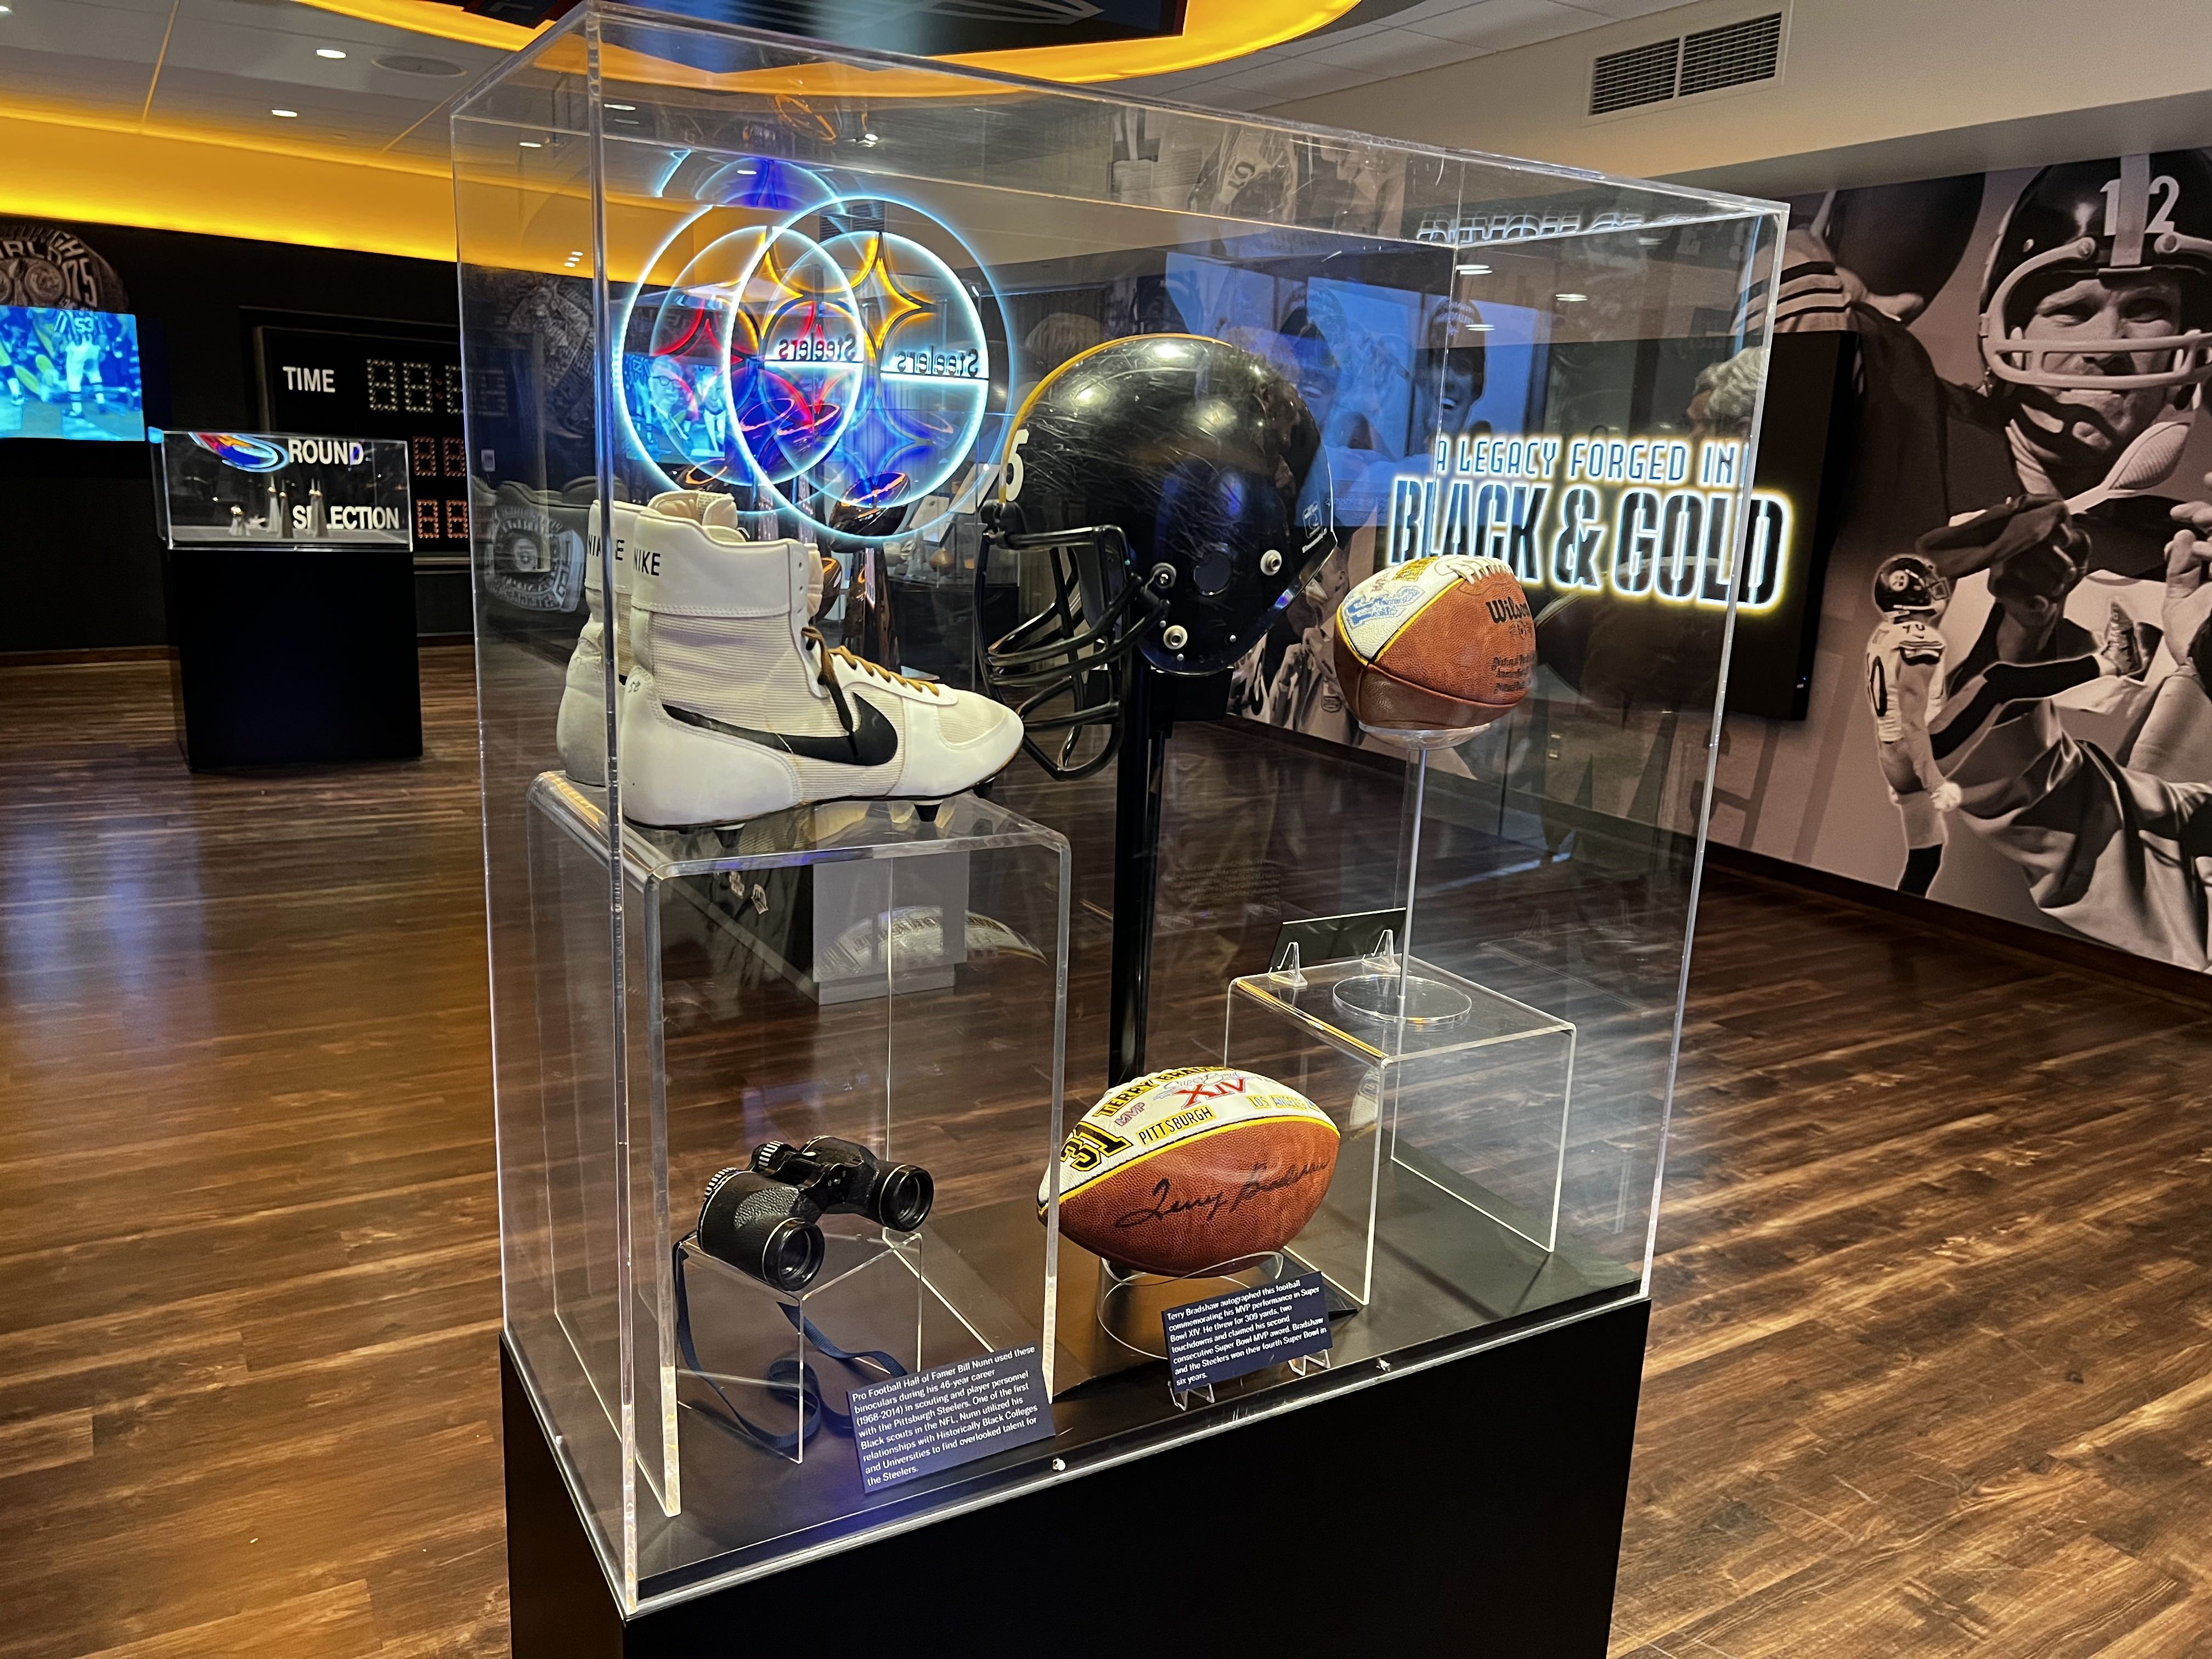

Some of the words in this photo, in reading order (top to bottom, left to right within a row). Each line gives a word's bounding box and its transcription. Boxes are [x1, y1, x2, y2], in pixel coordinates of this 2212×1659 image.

[2100, 176, 2180, 236] 12
[283, 365, 336, 393] TIME
[288, 439, 364, 465] ROUND
[1436, 439, 1448, 474] A
[1458, 439, 1560, 477] LEGACY
[1570, 440, 1688, 483] FORGED
[1701, 444, 1738, 487] IN
[292, 505, 400, 531] SECTION
[633, 547, 661, 577] NIKE
[1390, 476, 1549, 584] BLACK
[1553, 486, 1605, 590] &
[1612, 487, 1791, 607] GOLD
[1486, 596, 1532, 624] Wilson
[1114, 1102, 1147, 1127] MVP
[1173, 1077, 1246, 1110] XIV
[1249, 1096, 1269, 1107] LOS
[1060, 1121, 1134, 1172] 31
[1138, 1107, 1214, 1145] PITTSBURGH
[1167, 1312, 1184, 1321] Terry
[1186, 1302, 1219, 1316] Bradshaw
[1220, 1290, 1262, 1306] autographed
[1262, 1288, 1276, 1296] this
[1276, 1279, 1301, 1292] football
[1169, 1312, 1223, 1331] commemorating
[1223, 1308, 1234, 1317] his
[1235, 1303, 1251, 1314] MVP
[1251, 1294, 1293, 1311] performance
[1301, 1286, 1319, 1296] Super
[1170, 1333, 1188, 1342] Bowl
[1203, 1324, 1213, 1334] He
[1214, 1321, 1233, 1331] threw
[1234, 1317, 1243, 1325] for
[1244, 1312, 1259, 1323] 309
[1280, 1305, 1293, 1313] two
[1171, 1336, 1214, 1353] touchdowns
[1214, 1332, 1227, 1342] and
[1228, 1324, 1254, 1337] claimed
[1255, 1322, 1266, 1330] his
[1266, 1315, 1290, 1328] second
[1173, 1348, 1214, 1365] consecutive
[1214, 1342, 1234, 1353] Super
[1235, 1336, 1252, 1347] Bowl
[1253, 1330, 1269, 1342] MVP
[1269, 1326, 1291, 1337] award.
[1292, 1317, 1324, 1331] Bradshaw
[1175, 1365, 1188, 1375] and
[1189, 1363, 1201, 1372] the
[1201, 1355, 1230, 1368] Steelers
[1230, 1351, 1245, 1359] won
[1245, 1345, 1261, 1356] their
[1262, 1339, 1283, 1350] fourth
[1283, 1334, 1302, 1344] Super
[1303, 1328, 1319, 1339] Bowl
[852, 1393, 867, 1402] Pro
[868, 1381, 902, 1398] Football
[903, 1375, 920, 1388] Hall
[921, 1373, 929, 1383] of
[931, 1368, 956, 1380] Famer
[957, 1363, 970, 1374] Bill
[971, 1358, 994, 1370] Nunn
[994, 1351, 1013, 1363] used
[1014, 1346, 1035, 1358] these
[854, 1396, 898, 1415] binoculars
[899, 1387, 926, 1402] during
[926, 1383, 939, 1394] his
[939, 1376, 969, 1390] 46-year
[971, 1368, 995, 1382] career
[1176, 1378, 1187, 1386] six
[1187, 1372, 1208, 1385] years.
[856, 1405, 904, 1427] (1968-2014)
[905, 1402, 914, 1412] in
[915, 1392, 950, 1410] scouting
[950, 1388, 966, 1400] and
[966, 1382, 991, 1397] player
[991, 1370, 1029, 1389] personnel
[858, 1426, 877, 1438] with
[878, 1423, 892, 1433] the
[893, 1409, 936, 1428] Pittsburgh
[936, 1400, 972, 1416] Steelers.
[972, 1393, 989, 1406] One
[990, 1390, 998, 1401] of
[999, 1387, 1012, 1398] the
[1013, 1382, 1030, 1393] first
[860, 1436, 884, 1451] Black
[886, 1429, 913, 1443] scouts
[915, 1425, 923, 1434] in
[924, 1420, 938, 1431] the
[959, 1409, 981, 1422] Nunn
[982, 1401, 1011, 1415] utilized
[1011, 1396, 1024, 1407] his
[863, 1442, 916, 1463] relationships
[917, 1433, 935, 1446] with
[936, 1420, 981, 1440] Historically
[982, 1413, 1005, 1427] Black
[1005, 1404, 1039, 1420] Colleges
[865, 1463, 881, 1474] and
[882, 1448, 931, 1469] Universities
[932, 1444, 941, 1454] to
[942, 1439, 958, 1451] find
[959, 1426, 1001, 1446] overlooked
[1003, 1420, 1025, 1433] talent
[1026, 1416, 1037, 1426] for
[867, 1476, 881, 1486] the
[882, 1465, 919, 1482] Steelers.
